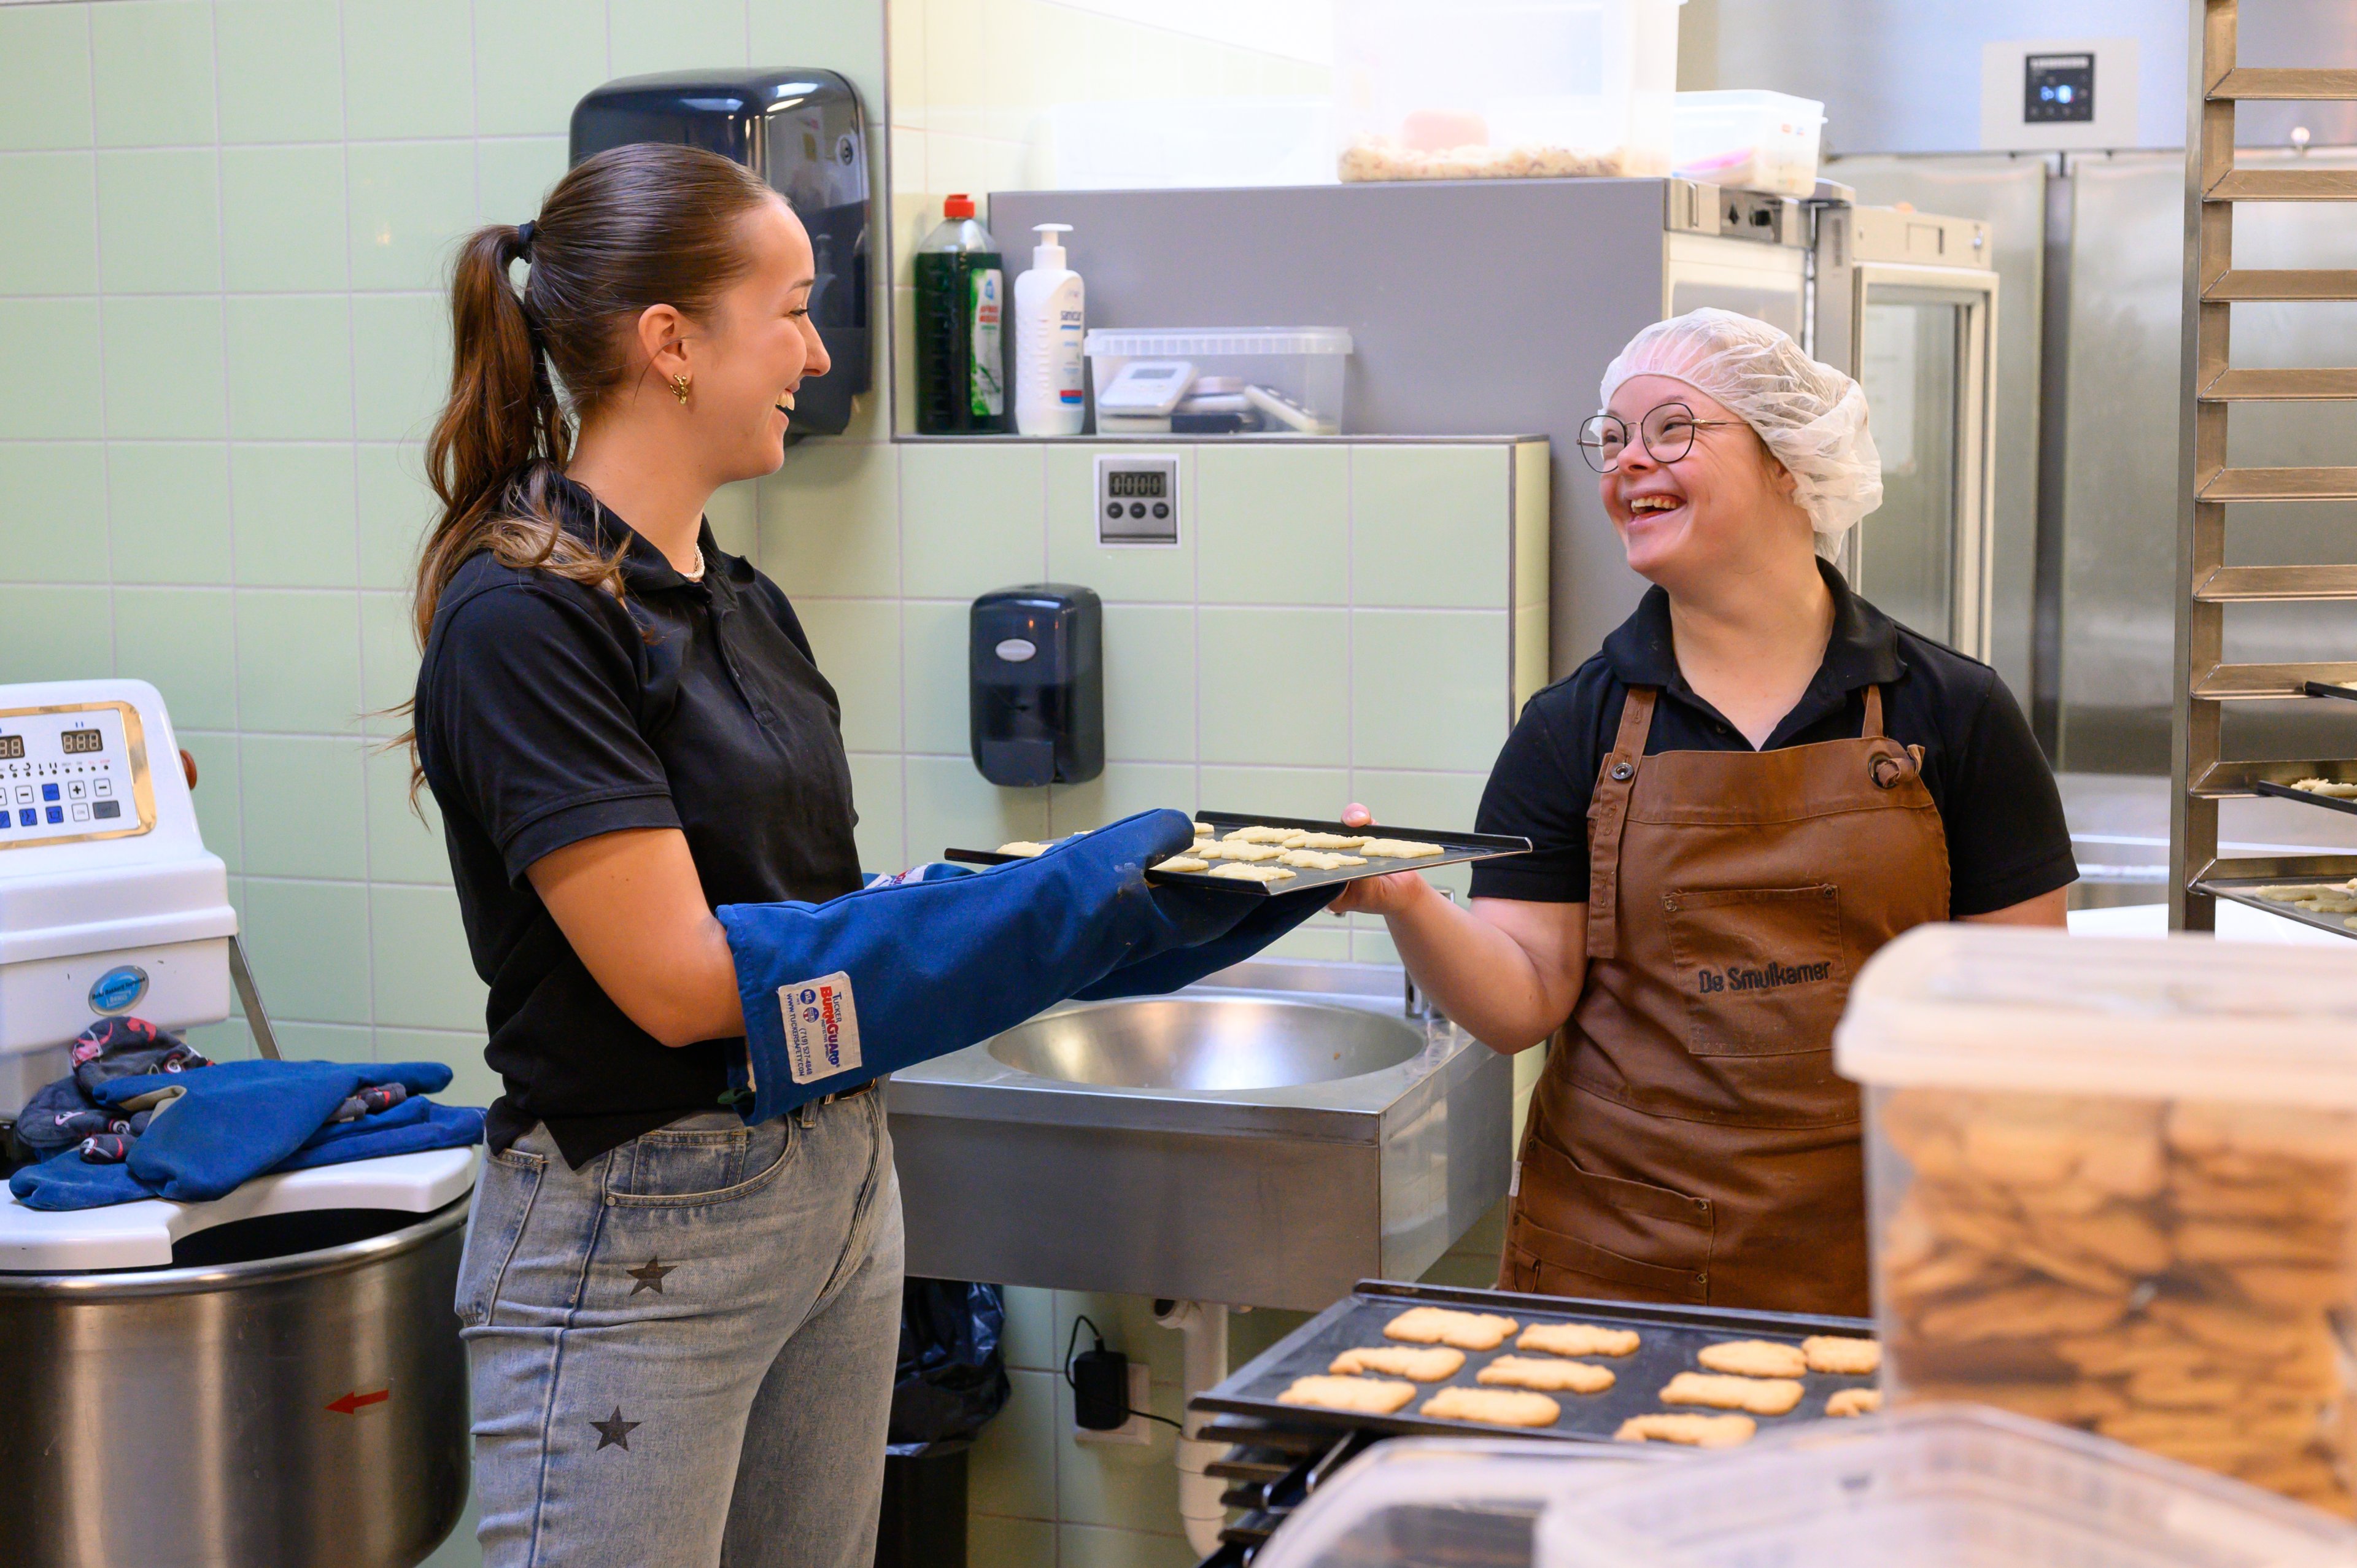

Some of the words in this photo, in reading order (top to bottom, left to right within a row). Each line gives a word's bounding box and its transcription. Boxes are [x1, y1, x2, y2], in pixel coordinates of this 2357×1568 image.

[1699, 970, 1725, 993] De
[1728, 962, 1831, 991] Smulkamer
[799, 1028, 808, 1046] (719)
[803, 1046, 813, 1075] 527-4848
